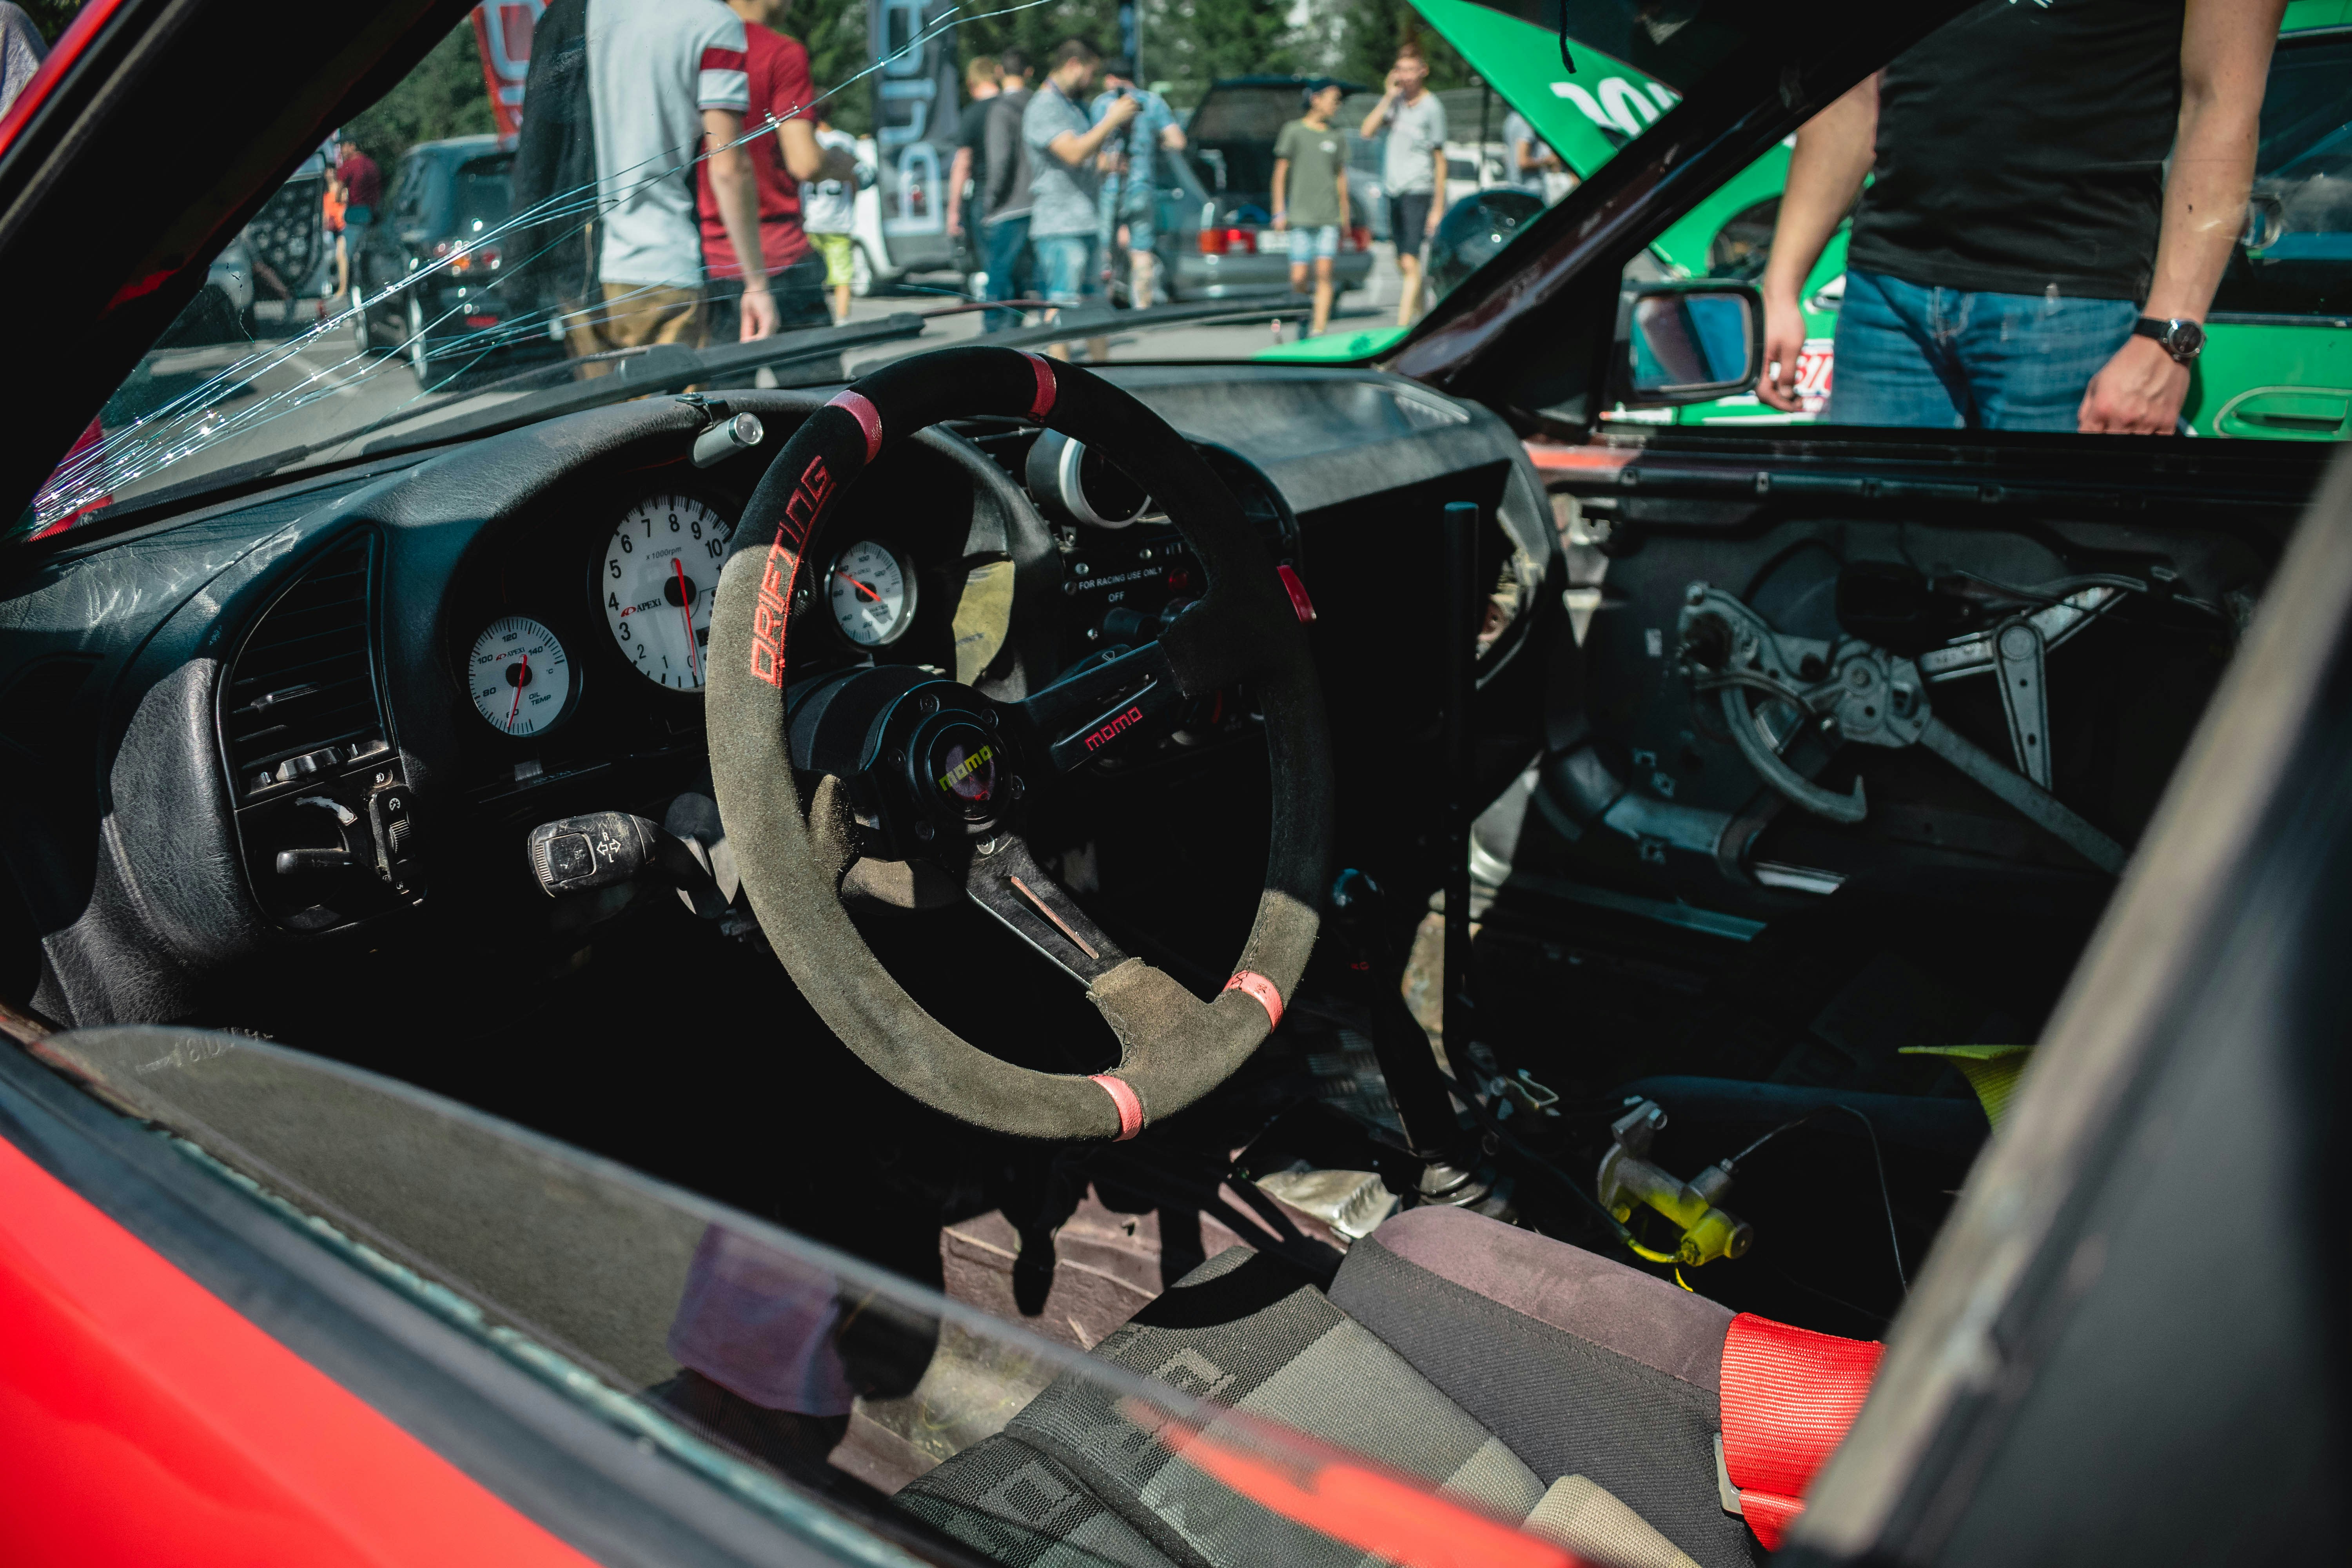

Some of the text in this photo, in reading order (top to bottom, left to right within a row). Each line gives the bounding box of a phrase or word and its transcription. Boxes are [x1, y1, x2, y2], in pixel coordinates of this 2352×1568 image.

[641, 519, 651, 537] 7
[669, 514, 680, 532] 8
[691, 521, 701, 539] 9
[621, 534, 633, 553] 6
[705, 538, 722, 558] 10
[652, 546, 682, 559] 1000rpm
[609, 559, 621, 579] 5
[751, 455, 832, 686] DRIFTING
[1078, 566, 1163, 590] FOR RACING USE ONLY
[608, 592, 619, 610] 4
[1108, 590, 1125, 603] OFF
[502, 632, 517, 642] 120
[619, 622, 631, 641] 3
[528, 646, 543, 656] 140
[637, 644, 646, 659] 2
[477, 654, 493, 664] 100
[662, 655, 668, 668] 1
[483, 687, 496, 697] 80
[531, 694, 551, 705] TEMP
[602, 832, 609, 841] R
[608, 853, 614, 863] L
